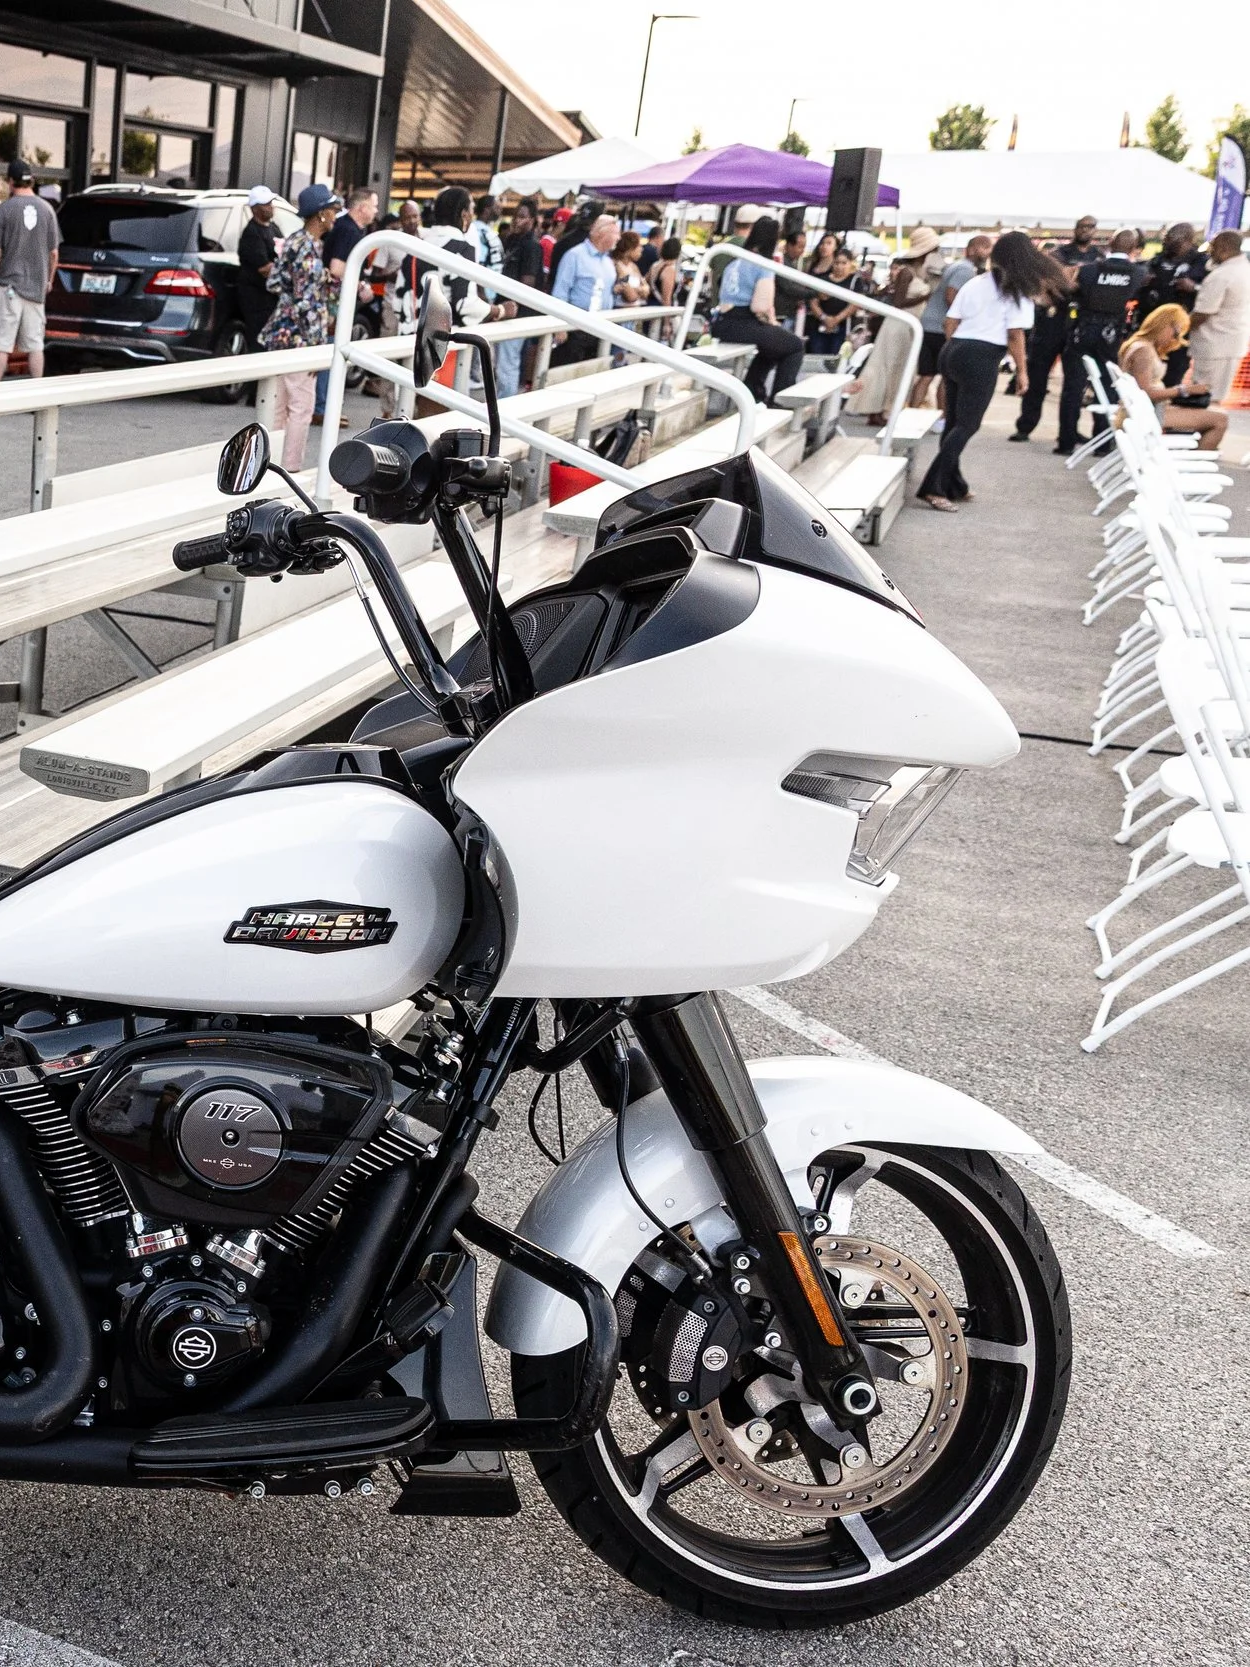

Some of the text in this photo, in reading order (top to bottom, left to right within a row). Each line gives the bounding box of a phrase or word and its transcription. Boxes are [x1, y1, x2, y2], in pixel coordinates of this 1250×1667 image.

[36, 756, 132, 782] ALUM-A-STANDS
[249, 912, 383, 927] HARLEY-
[231, 926, 392, 941] DAVIDSON
[204, 1101, 263, 1123] 117
